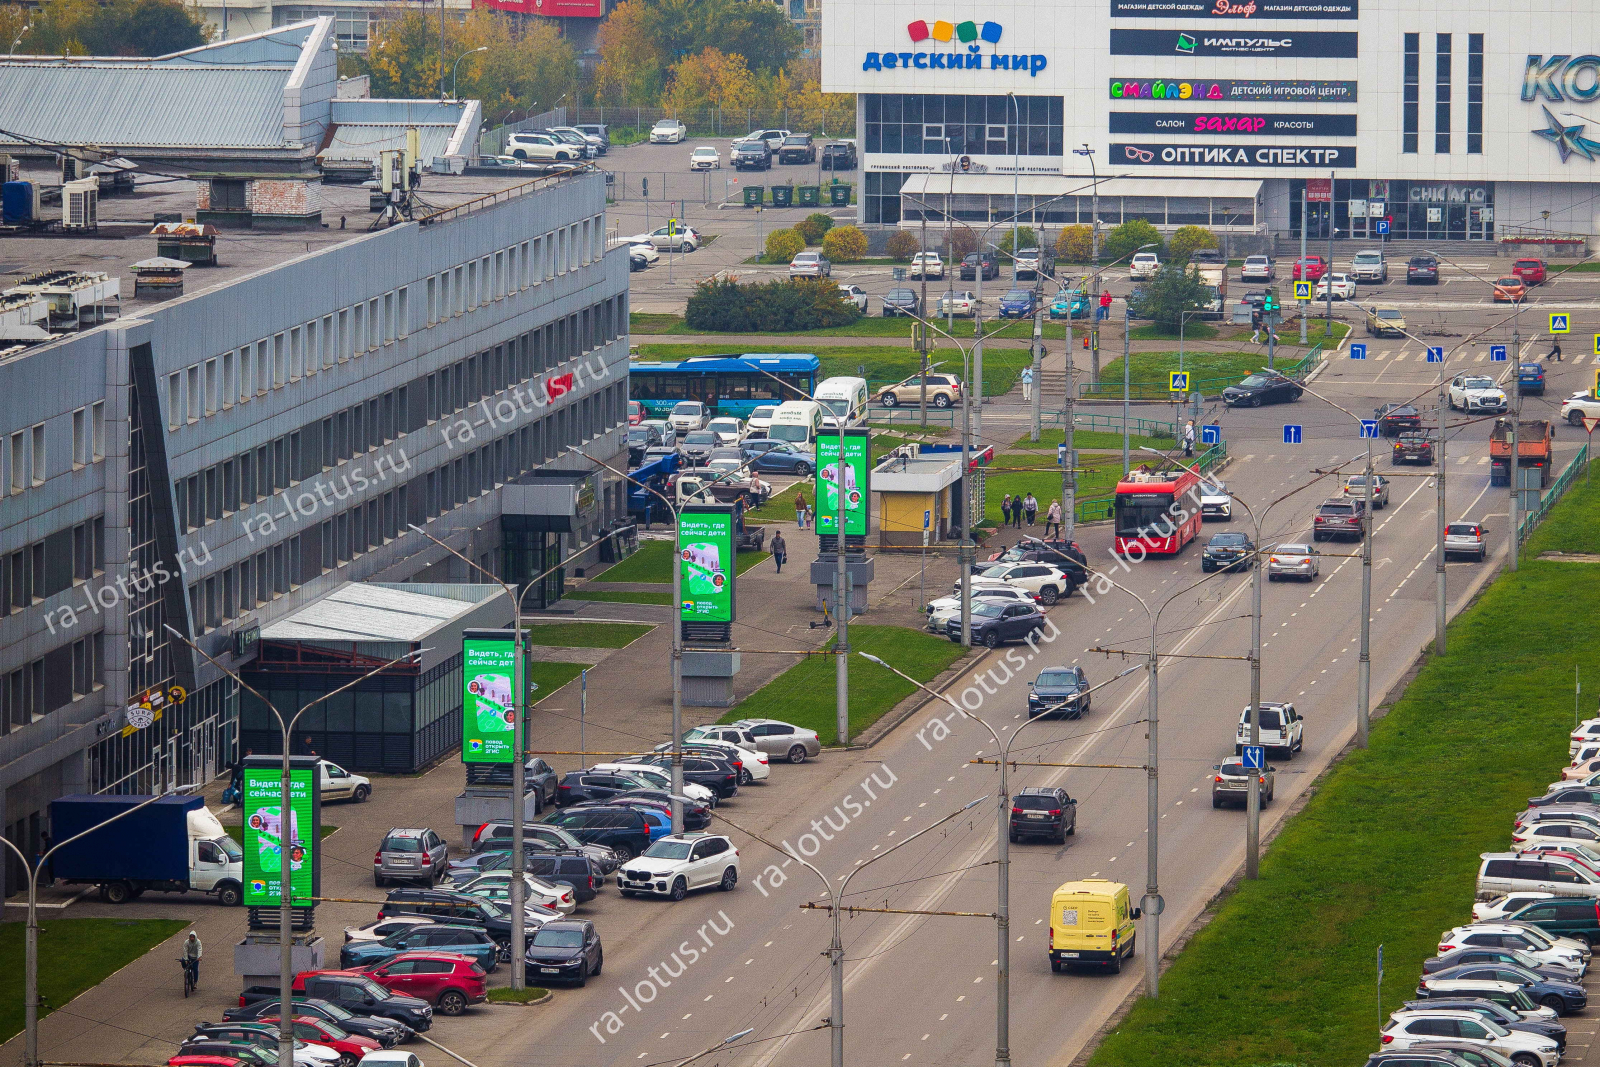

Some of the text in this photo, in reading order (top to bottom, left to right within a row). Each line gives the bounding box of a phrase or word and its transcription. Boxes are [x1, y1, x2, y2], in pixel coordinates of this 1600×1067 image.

[1204, 38, 1292, 48] ИМПУЛЬС
[990, 53, 1048, 77] мир
[1111, 80, 1224, 100] СМАЙЛЭНД
[1230, 86, 1348, 97] ДЕТСКИЙ ИГРОВОЙ ЦЕНТР
[1156, 120, 1185, 128] САЛОН
[1274, 121, 1314, 129] КРАСОТЫ
[1161, 148, 1339, 164] ОПТИКА СПЕКТР
[1410, 186, 1486, 202] CHICAGO
[469, 649, 502, 658] Видеть,
[250, 789, 282, 797] сейчас
